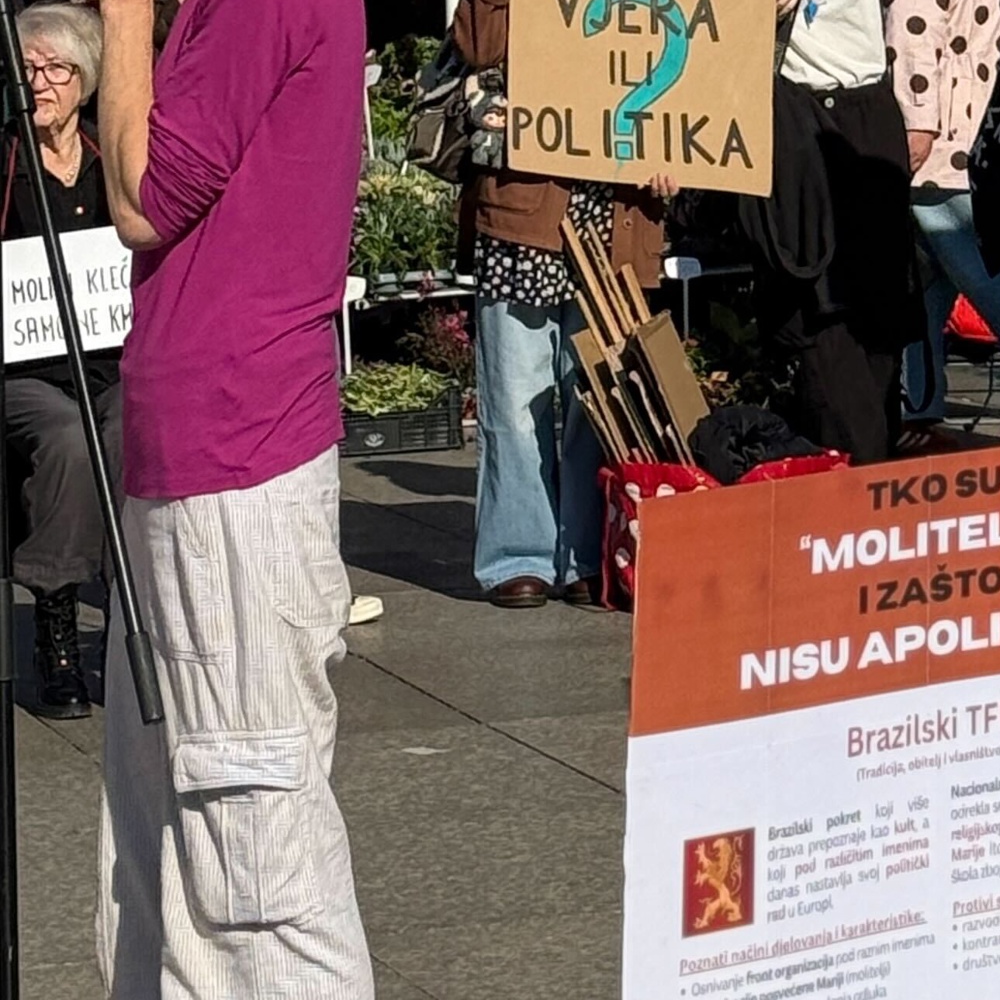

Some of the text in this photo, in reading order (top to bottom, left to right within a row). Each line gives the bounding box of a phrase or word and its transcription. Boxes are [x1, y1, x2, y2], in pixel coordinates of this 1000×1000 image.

[609, 51, 653, 86] ILI
[512, 107, 753, 169] POLITIKA
[867, 474, 947, 511] TKO
[859, 584, 868, 614] I
[740, 637, 850, 689] NISU
[847, 707, 957, 758] Brazilski
[908, 754, 941, 771] obitelj
[953, 896, 994, 916] Protivi
